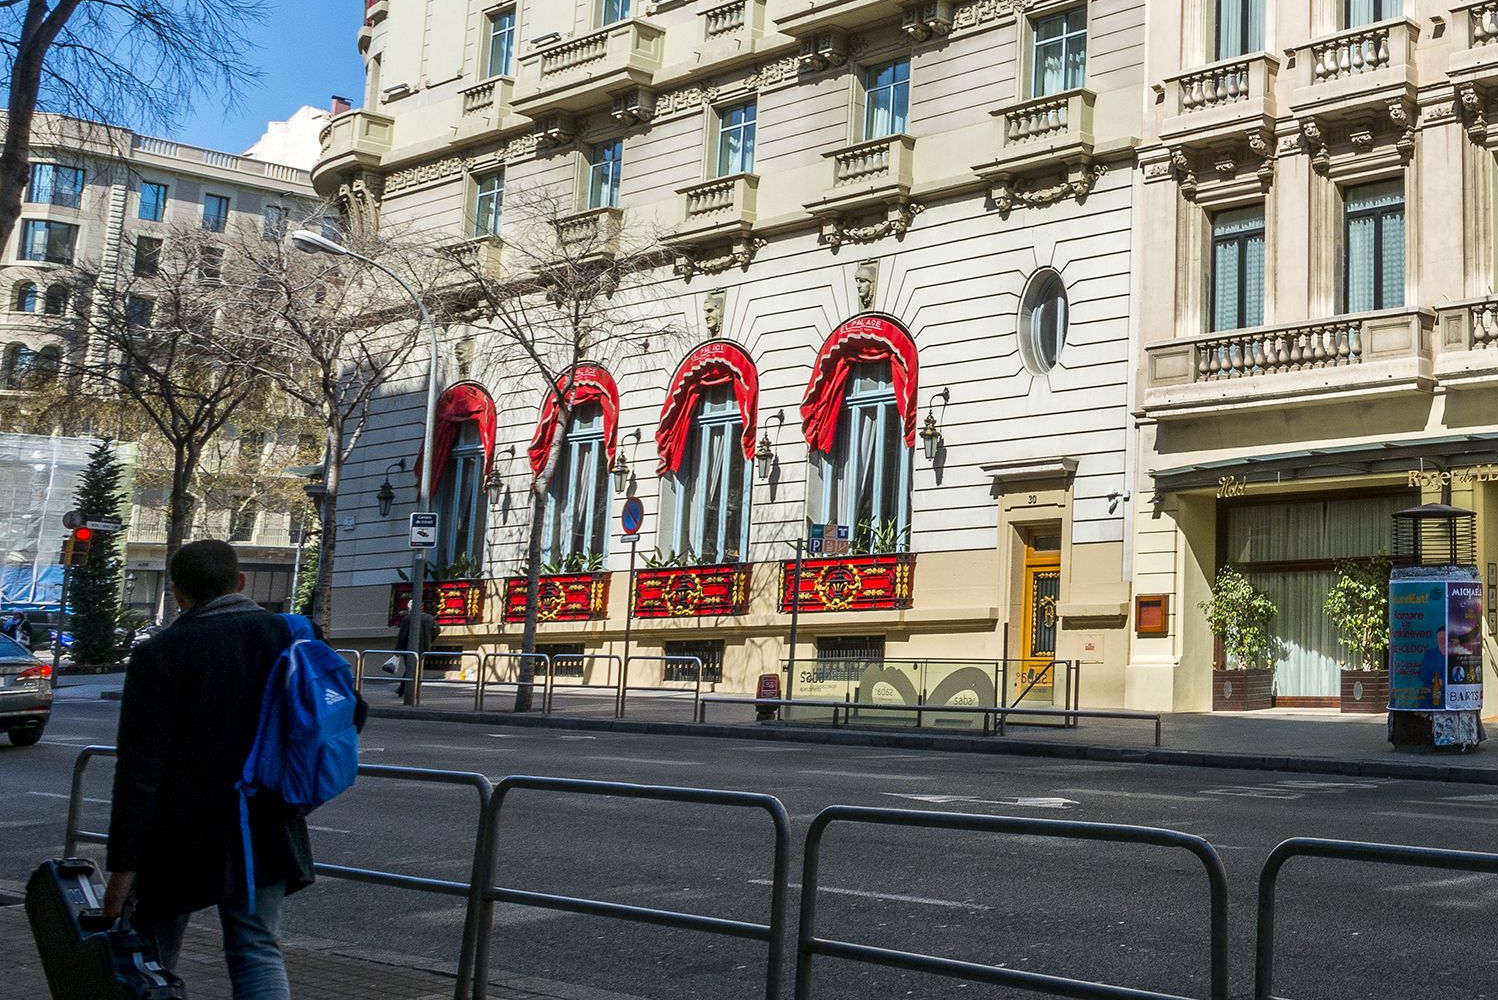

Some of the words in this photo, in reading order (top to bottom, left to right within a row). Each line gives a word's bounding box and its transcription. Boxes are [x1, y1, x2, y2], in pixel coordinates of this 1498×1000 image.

[1407, 469, 1458, 491] Roger
[1216, 475, 1247, 499] Hotel
[1028, 495, 1037, 504] 30
[813, 539, 821, 551] P
[954, 694, 974, 706] saba
